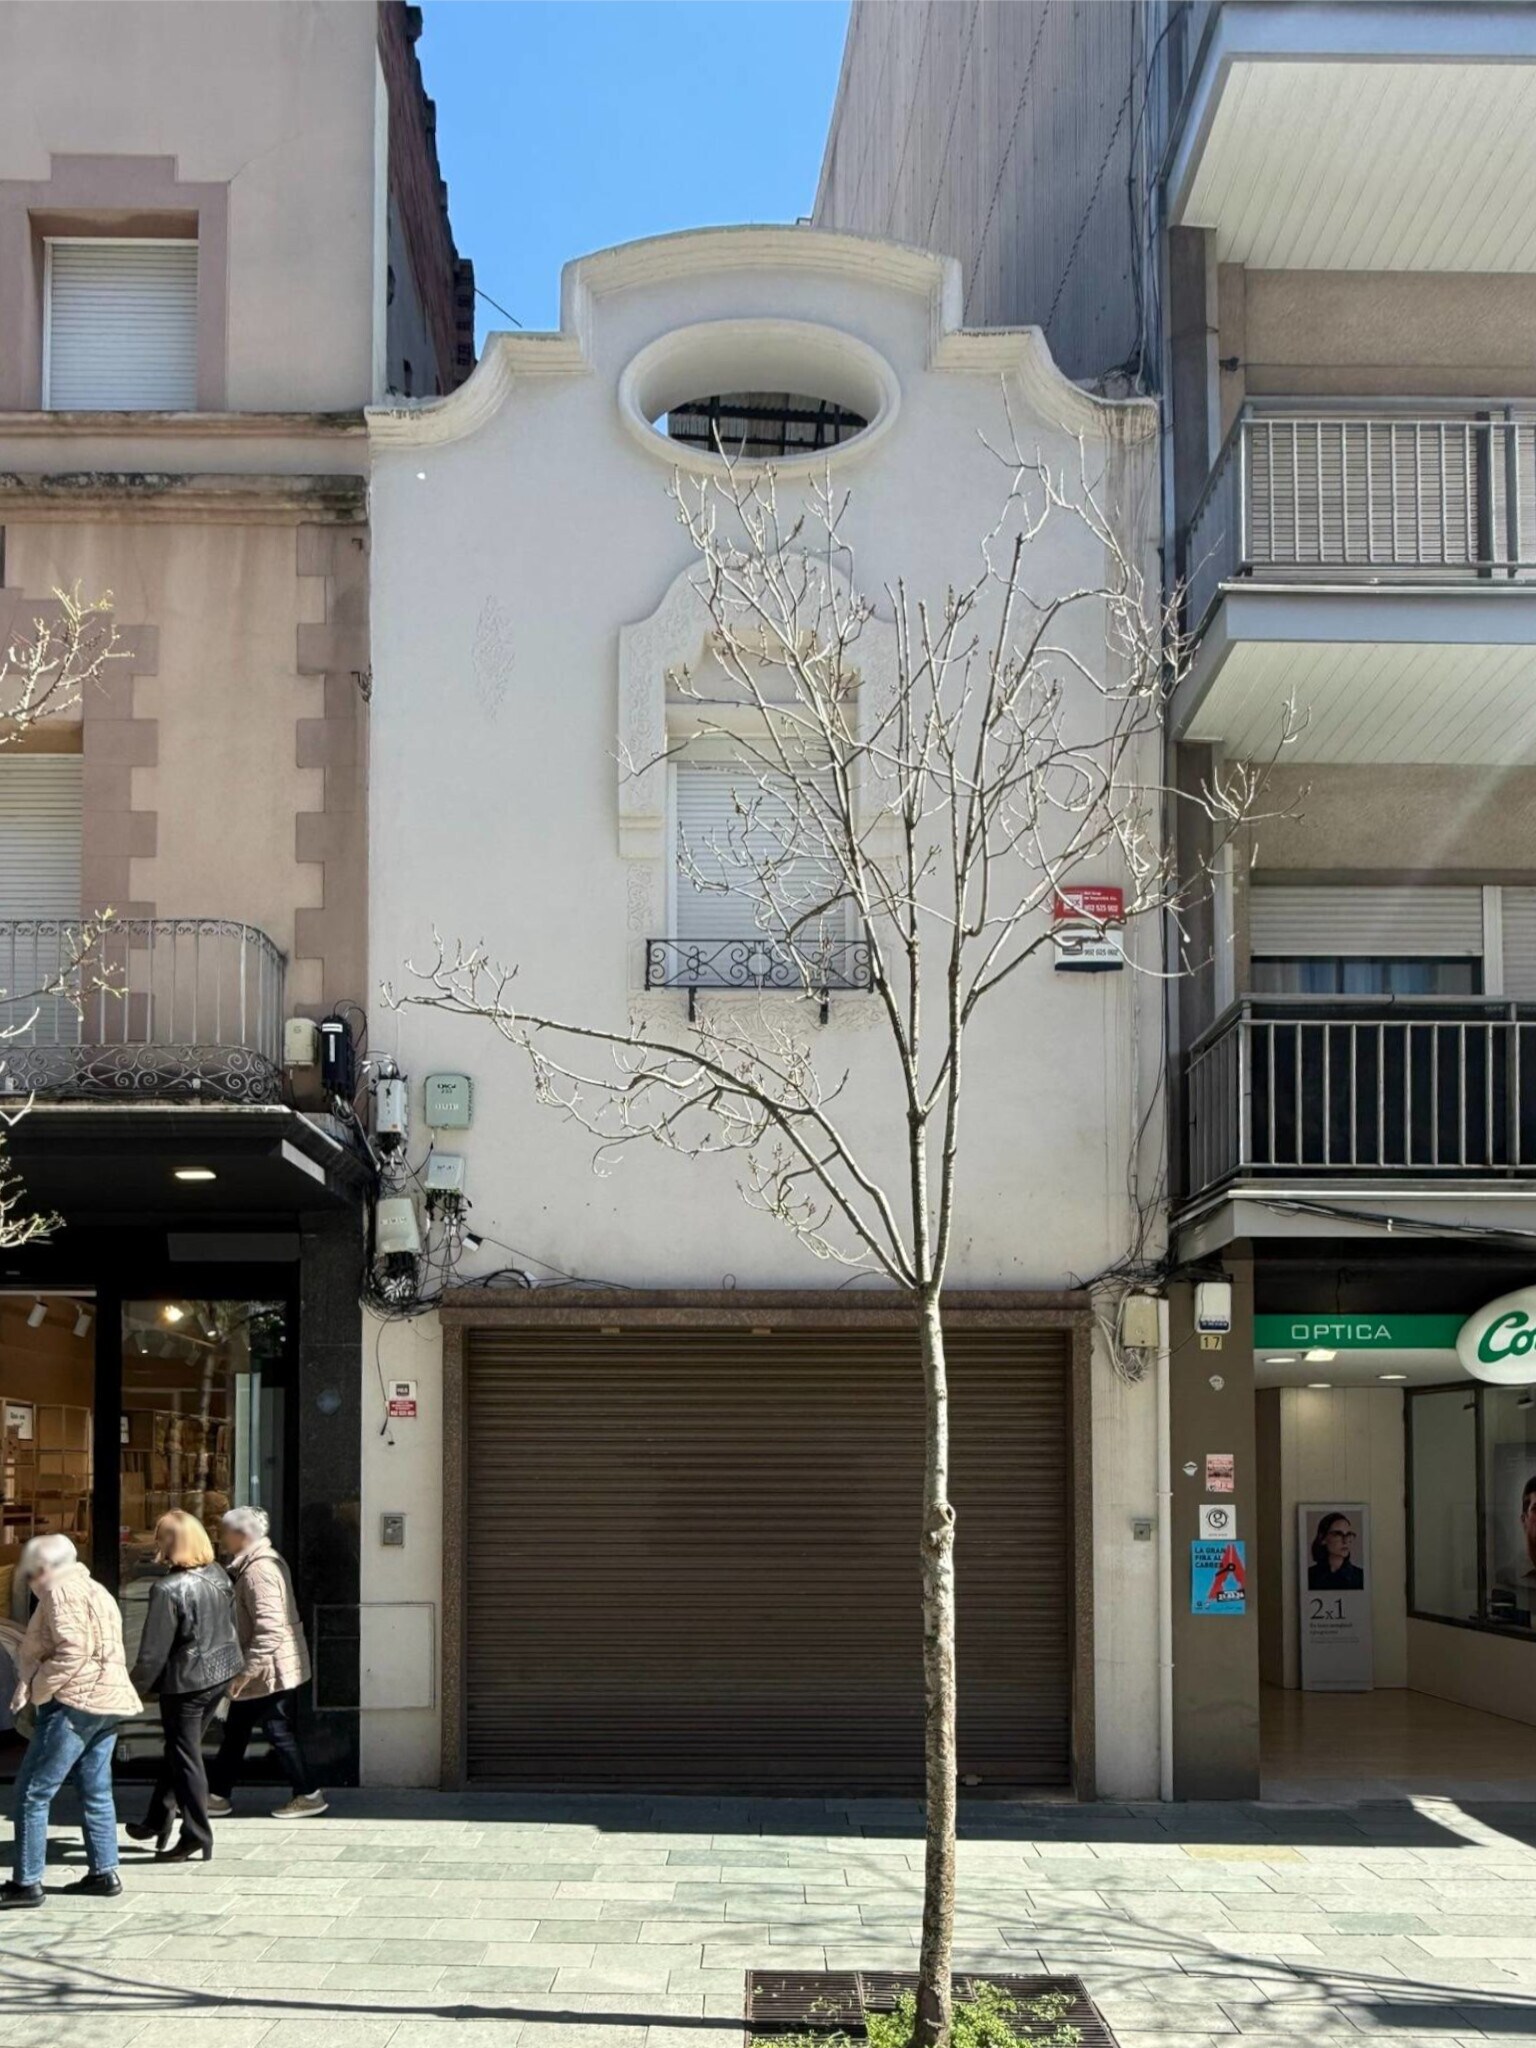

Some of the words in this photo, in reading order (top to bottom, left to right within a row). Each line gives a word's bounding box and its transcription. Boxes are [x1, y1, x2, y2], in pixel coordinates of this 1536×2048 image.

[1291, 1324, 1392, 1340] OPTICA
[1478, 1310, 1536, 1364] Co
[1203, 1336, 1220, 1348] 17
[1309, 1598, 1346, 1620] 2x1
